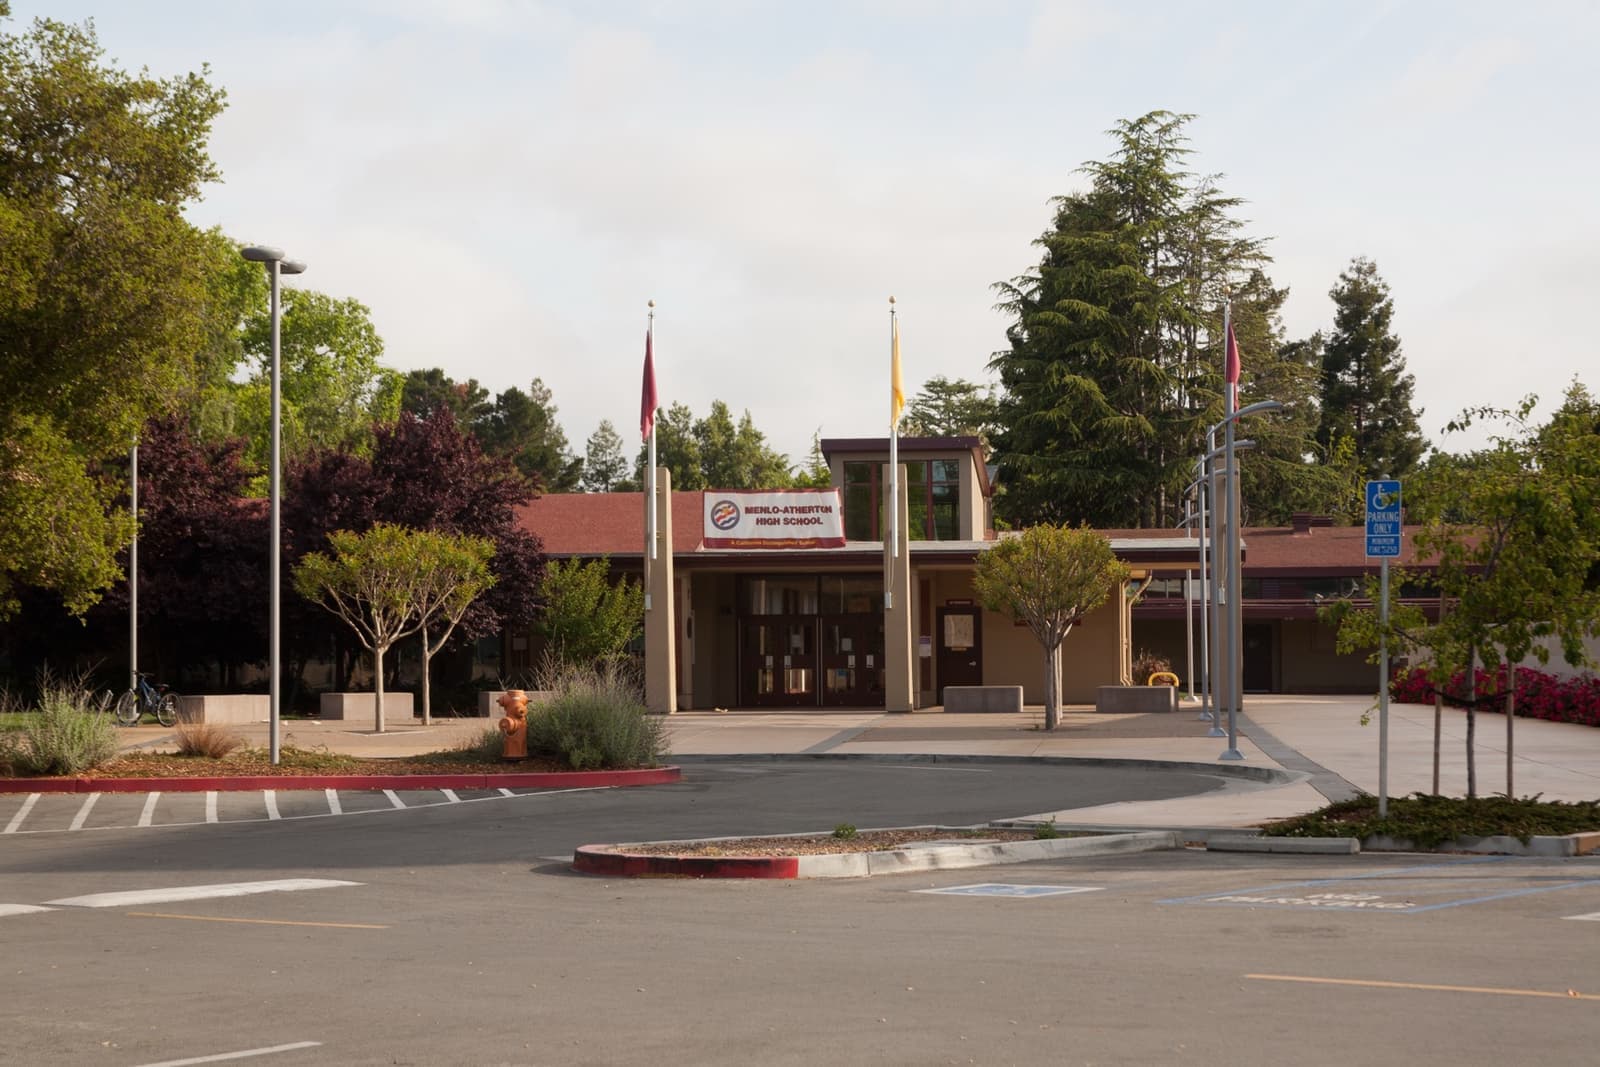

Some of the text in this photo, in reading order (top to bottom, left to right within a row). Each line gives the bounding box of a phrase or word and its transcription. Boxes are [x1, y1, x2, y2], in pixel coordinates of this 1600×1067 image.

[744, 505, 832, 514] MENLO-ATHERTON
[755, 517, 823, 526] HIGH SCHOOL
[1368, 511, 1399, 522] PARKING
[1374, 523, 1392, 534] ONLY
